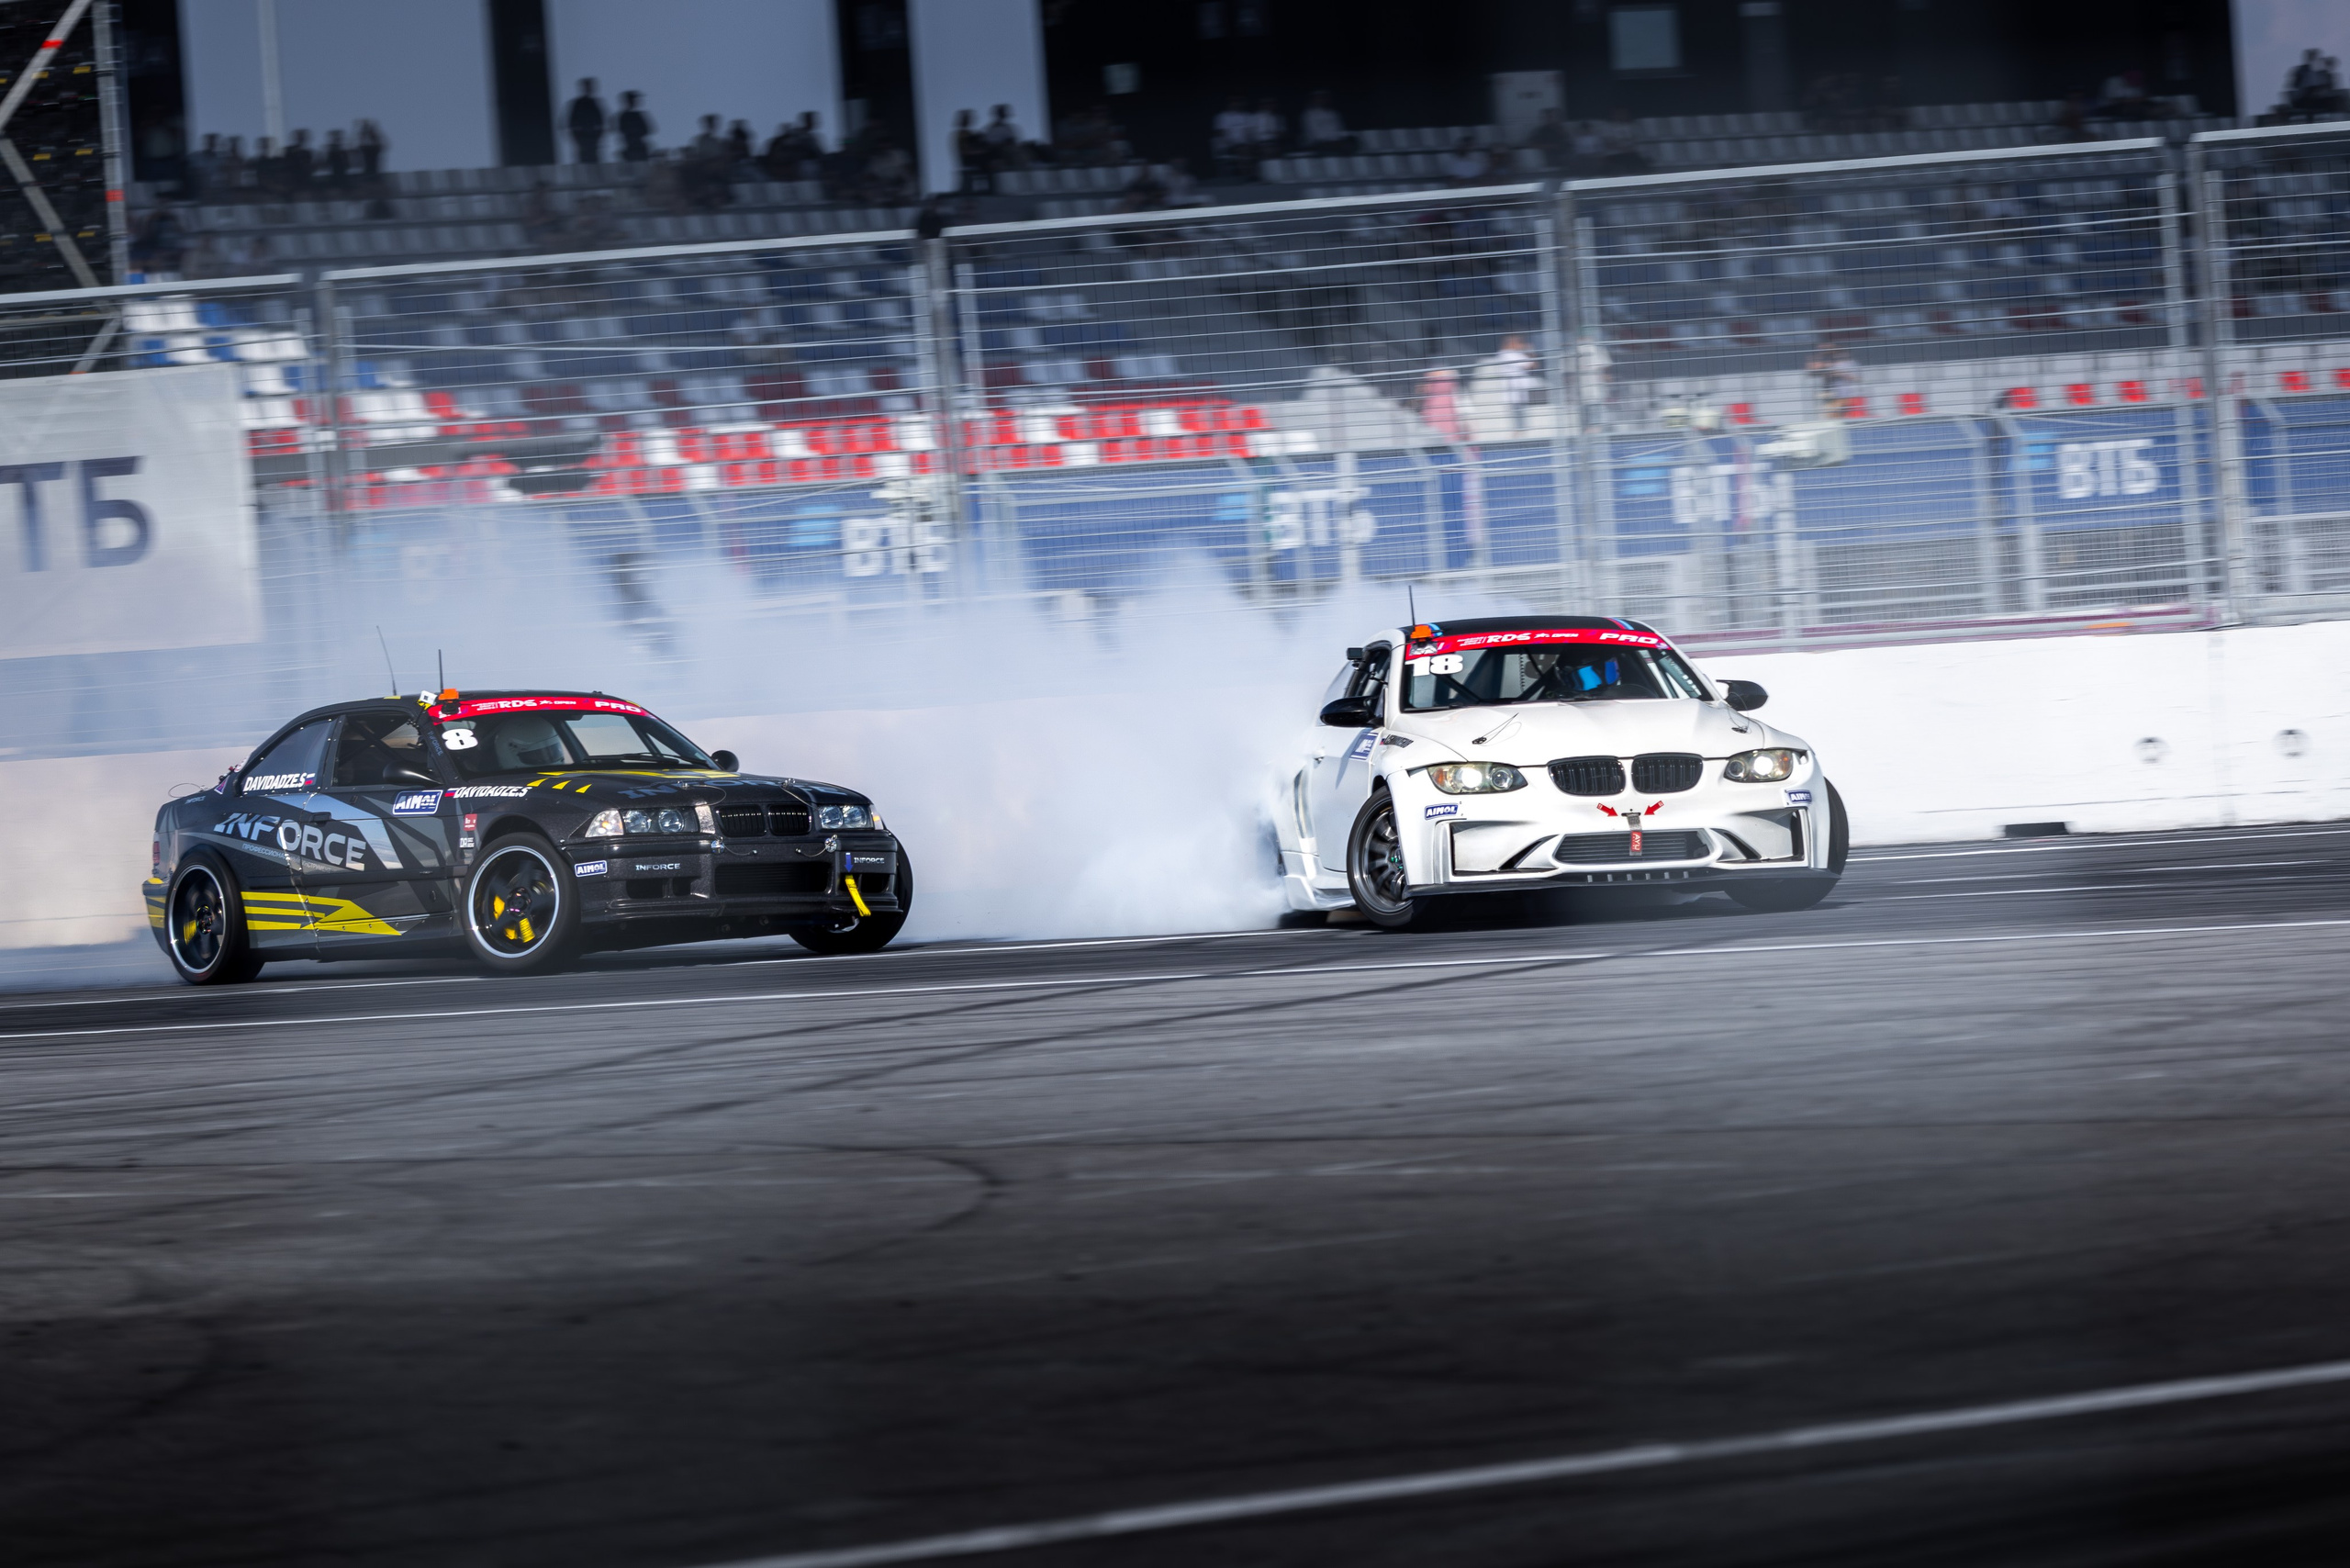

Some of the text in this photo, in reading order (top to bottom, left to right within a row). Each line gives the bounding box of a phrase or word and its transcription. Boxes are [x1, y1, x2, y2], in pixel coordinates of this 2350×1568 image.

[2057, 439, 2159, 498] ВТБ
[1487, 633, 1532, 644] RDS
[1599, 633, 1659, 644] PRO
[1405, 654, 1463, 677] 18
[498, 700, 537, 709] RDS
[594, 700, 642, 713] PRO
[442, 729, 478, 751] 8
[242, 772, 308, 791] DAVIDADZE.S
[395, 794, 437, 810] AIMOL
[1427, 806, 1457, 817] AIMOL
[213, 812, 366, 871] INFORCE
[576, 864, 606, 875] AIMOL
[635, 863, 681, 871] INFORCE
